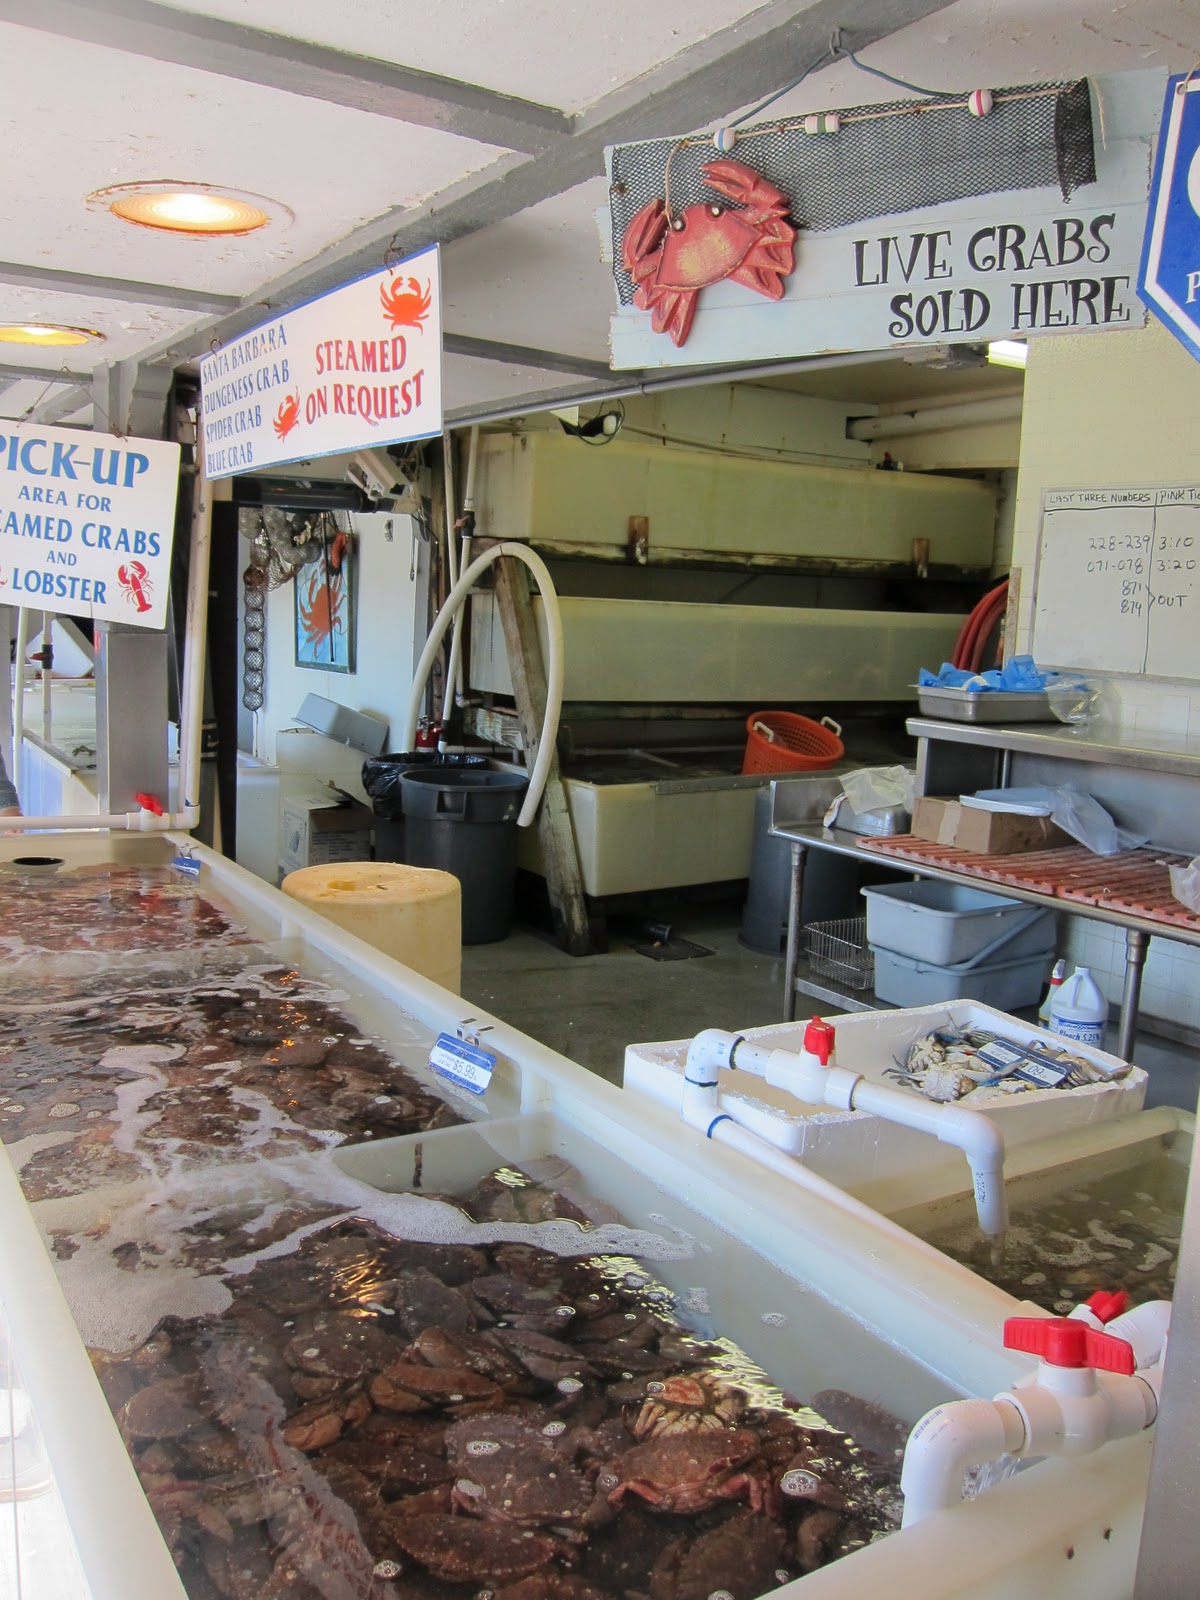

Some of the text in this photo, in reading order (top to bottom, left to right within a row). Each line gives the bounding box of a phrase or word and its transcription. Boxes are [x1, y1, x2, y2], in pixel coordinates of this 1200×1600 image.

[852, 213, 1116, 287] LIVE CRABS
[889, 276, 1130, 338] SOLD HERE
[203, 324, 288, 385] SANTA BARBARA
[316, 335, 406, 375] STEAMED
[204, 359, 290, 414] DUNGENESS CRAB
[306, 369, 424, 427] ON REQUEST
[206, 405, 262, 444] SPIDER CRAB
[0, 434, 149, 488] ICK-UP
[207, 442, 253, 474] BLUE CRAB
[18, 485, 112, 512] AREA FOR
[1050, 493, 1075, 503] LAST
[1078, 493, 1107, 503] THREE
[0, 509, 161, 557] AMED CRABS
[1089, 535, 1150, 553] 228-239
[1159, 536, 1194, 550] 3:10
[46, 550, 77, 567] AND
[1087, 557, 1143, 574] 071-078
[1156, 559, 1196, 572] 3:20
[12, 567, 107, 604] LOBSTER
[1122, 580, 1142, 596] 871
[1157, 594, 1188, 607] OUT
[453, 1059, 476, 1079] $5.99
